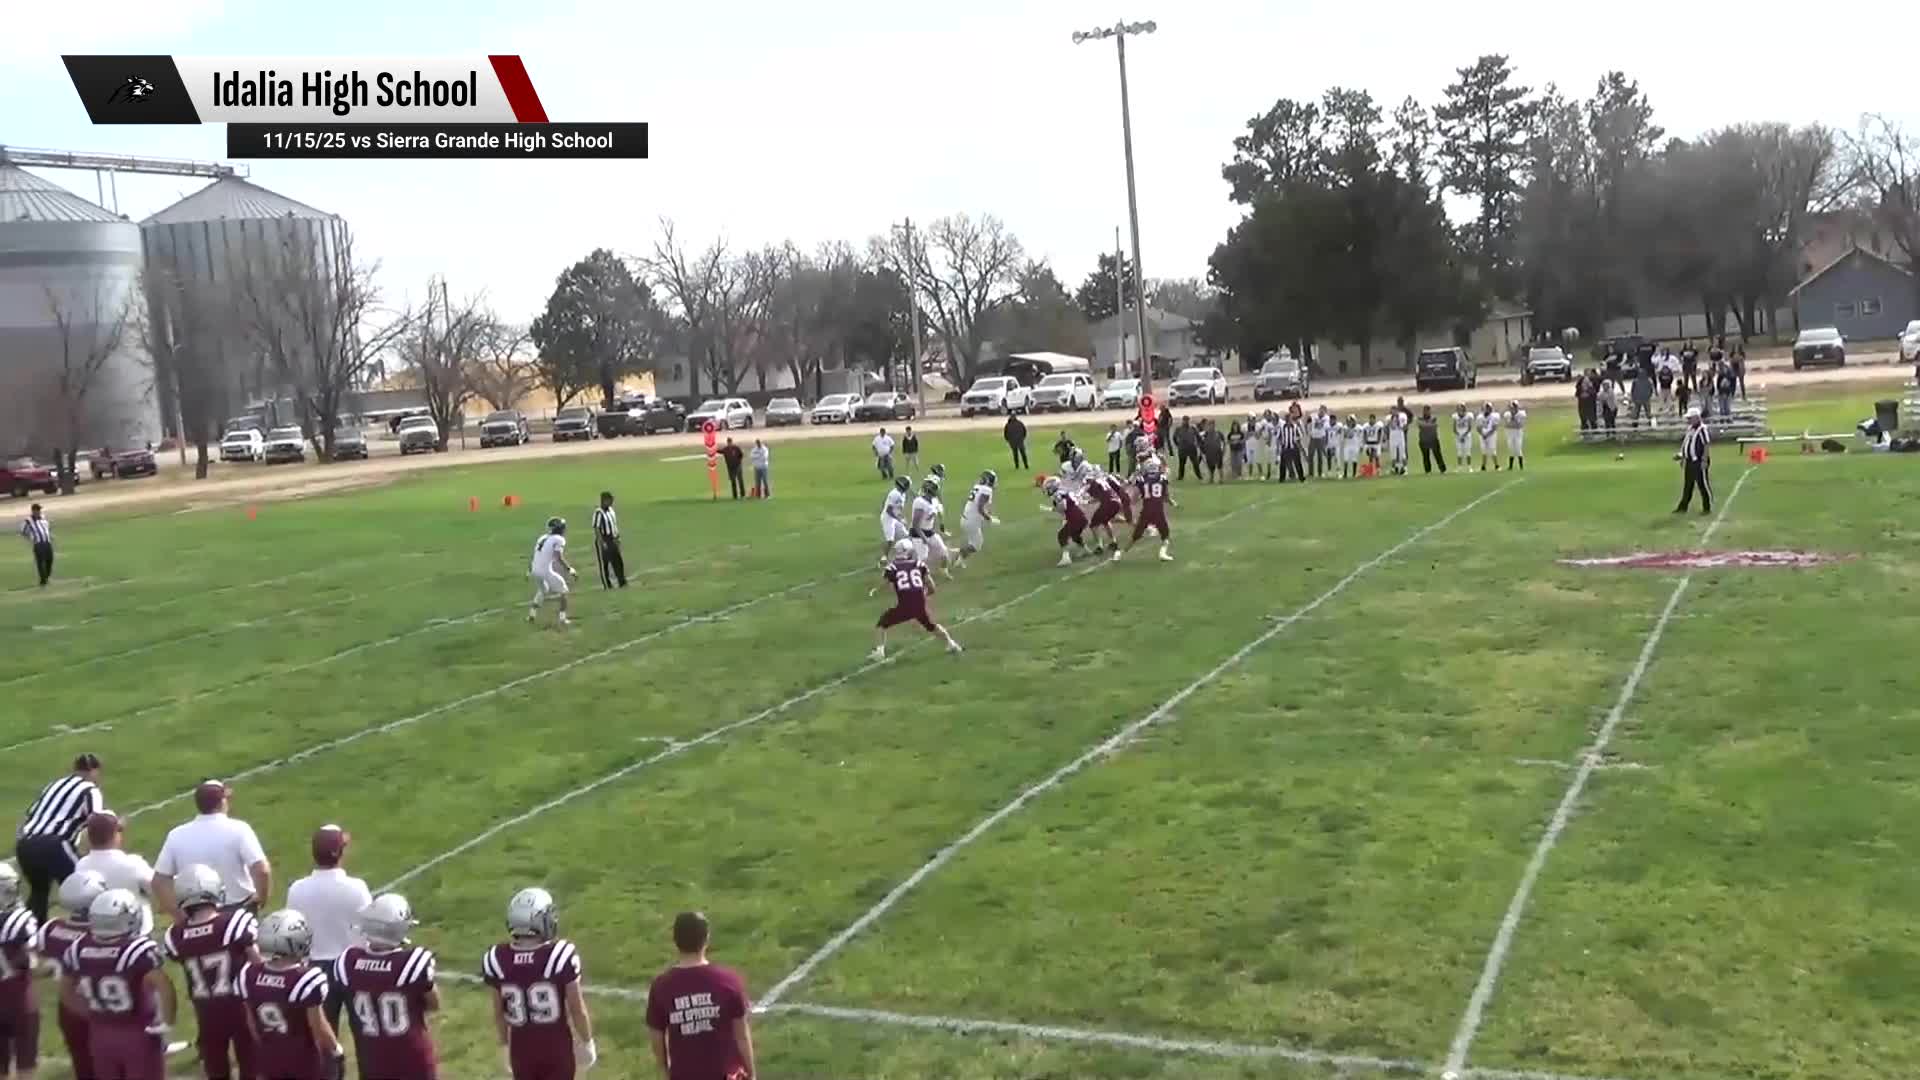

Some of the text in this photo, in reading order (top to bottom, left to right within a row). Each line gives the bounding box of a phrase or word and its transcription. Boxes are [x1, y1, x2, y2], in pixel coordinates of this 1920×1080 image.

[896, 569, 923, 590] 26
[185, 951, 231, 997] 17
[256, 1001, 288, 1034] 9
[353, 990, 410, 1037] 40
[500, 982, 561, 1026] 39
